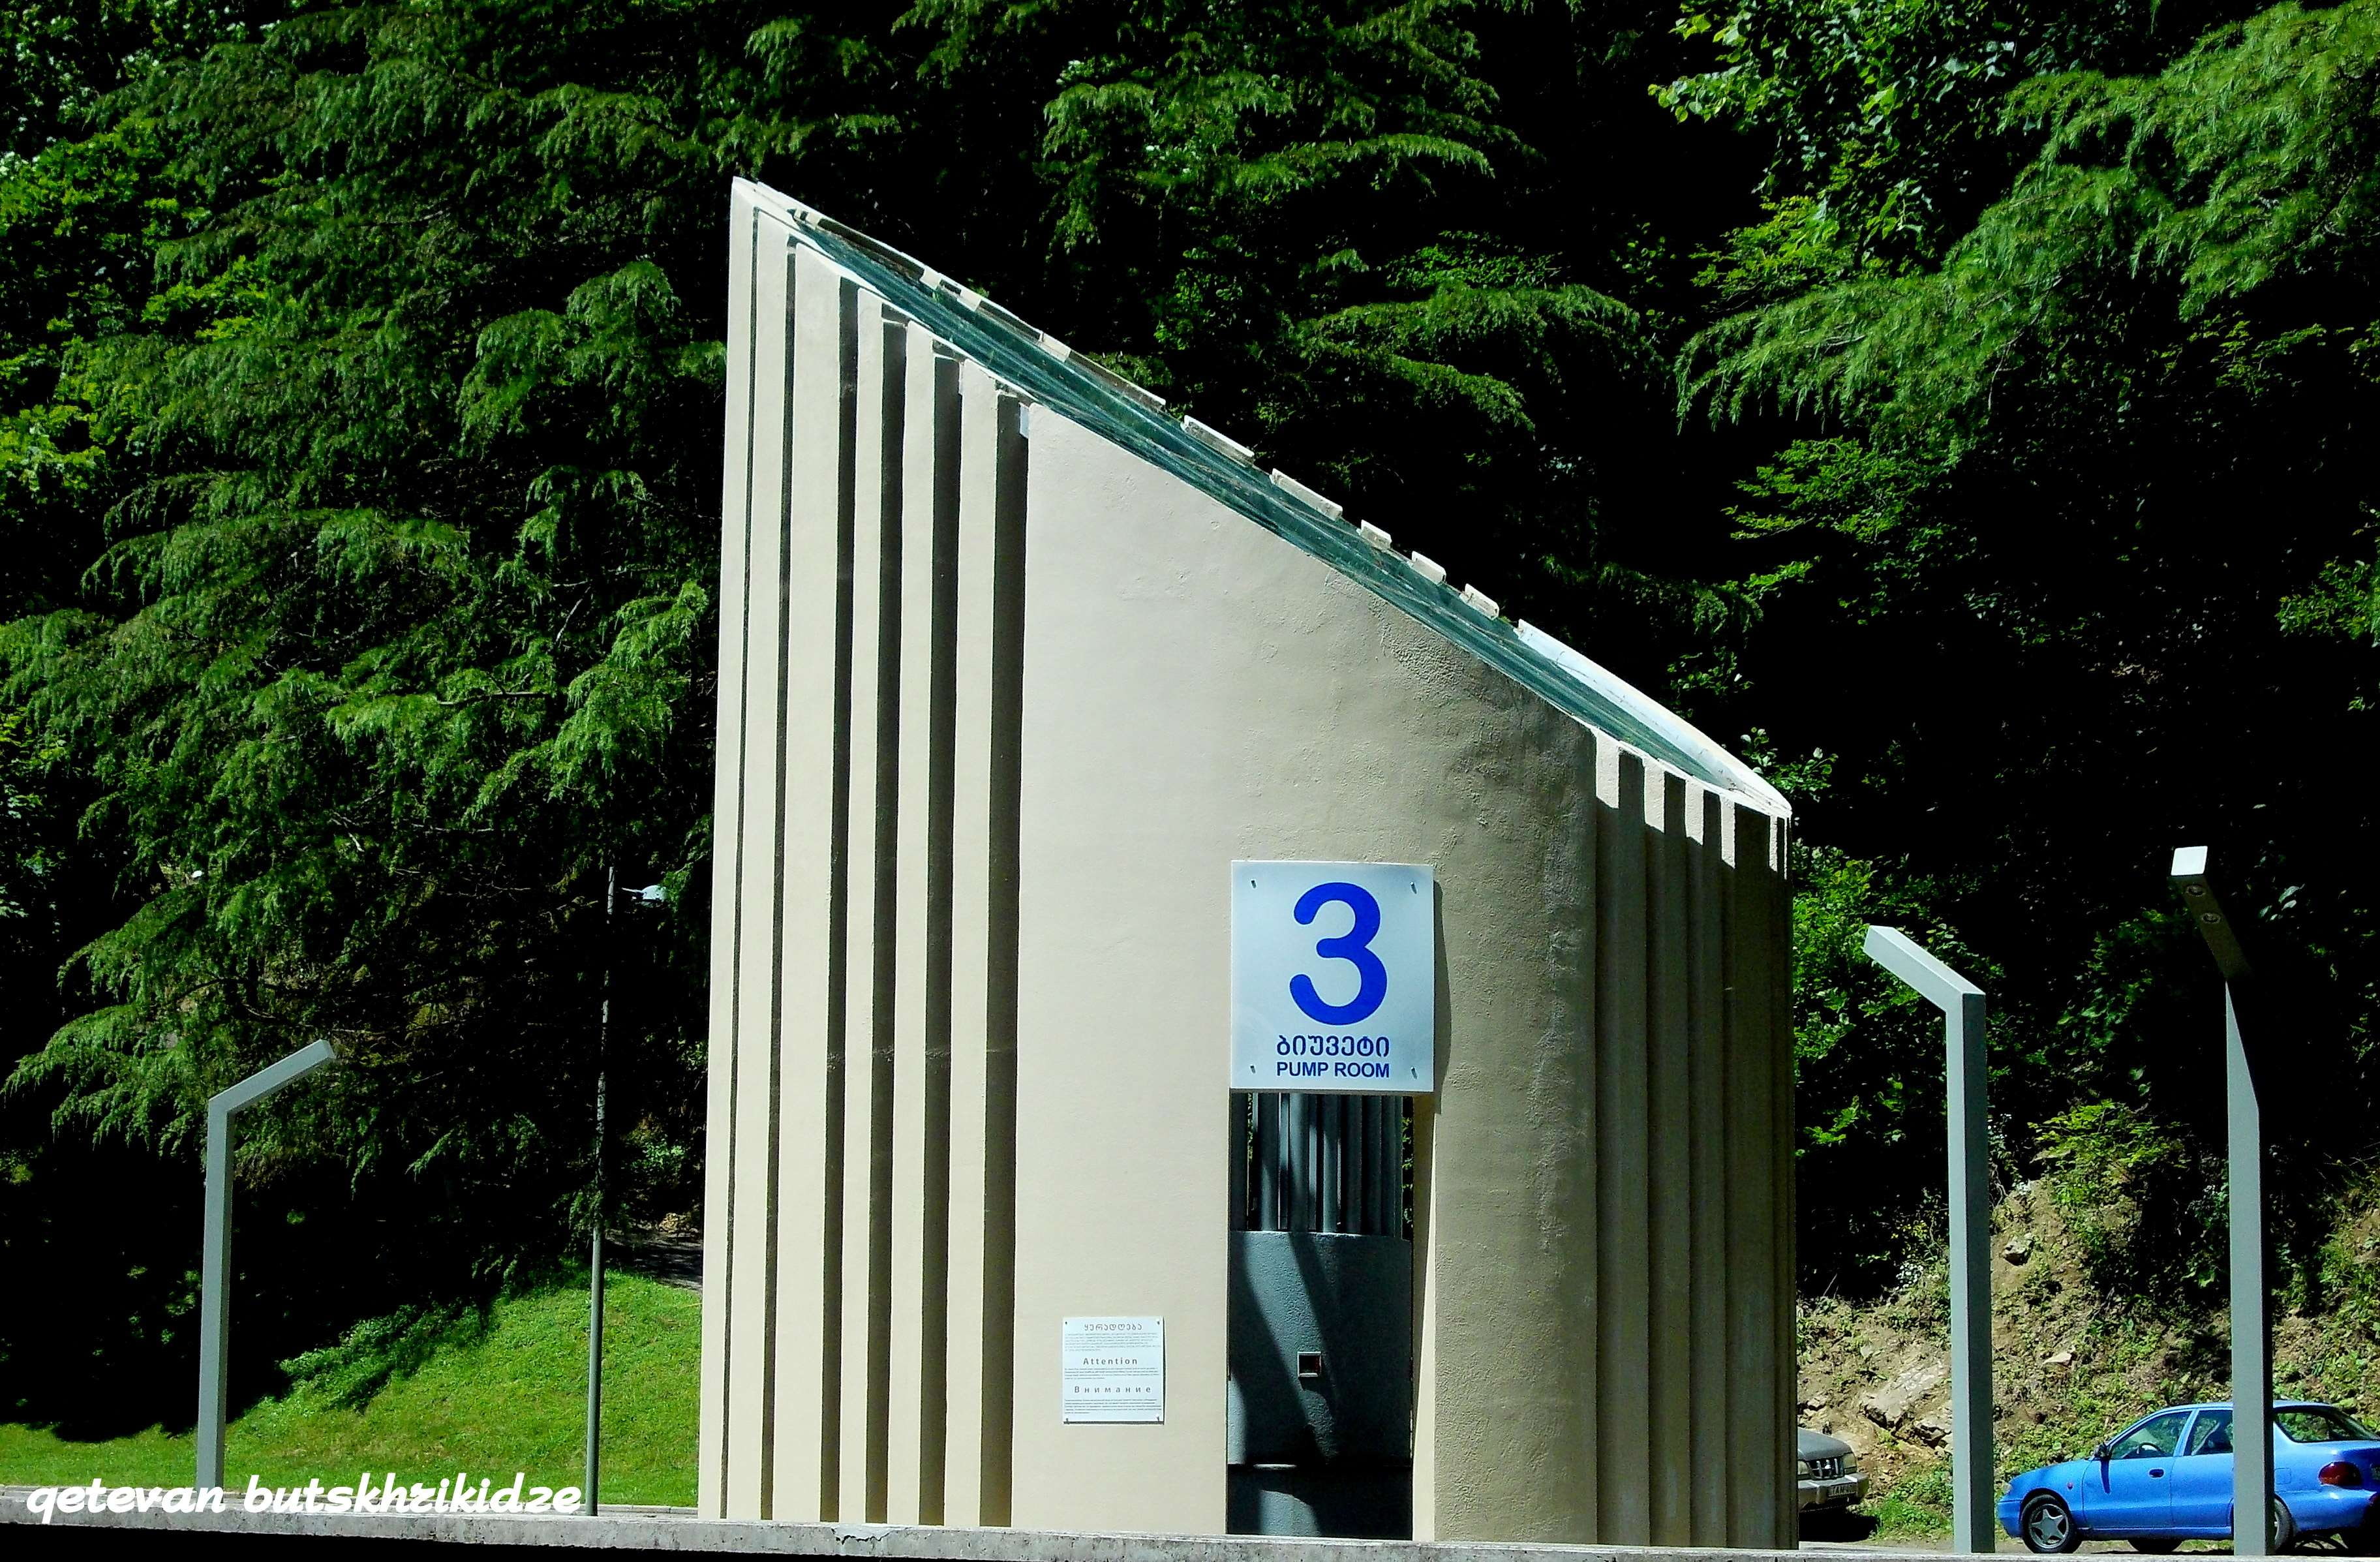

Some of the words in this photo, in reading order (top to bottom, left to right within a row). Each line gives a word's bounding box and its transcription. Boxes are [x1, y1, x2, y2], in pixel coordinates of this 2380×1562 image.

[1290, 882, 1388, 1026] 3
[1276, 1035, 1390, 1058] ბიუვეტი
[1277, 1062, 1328, 1077] PUMP
[1334, 1062, 1390, 1078] ROOM
